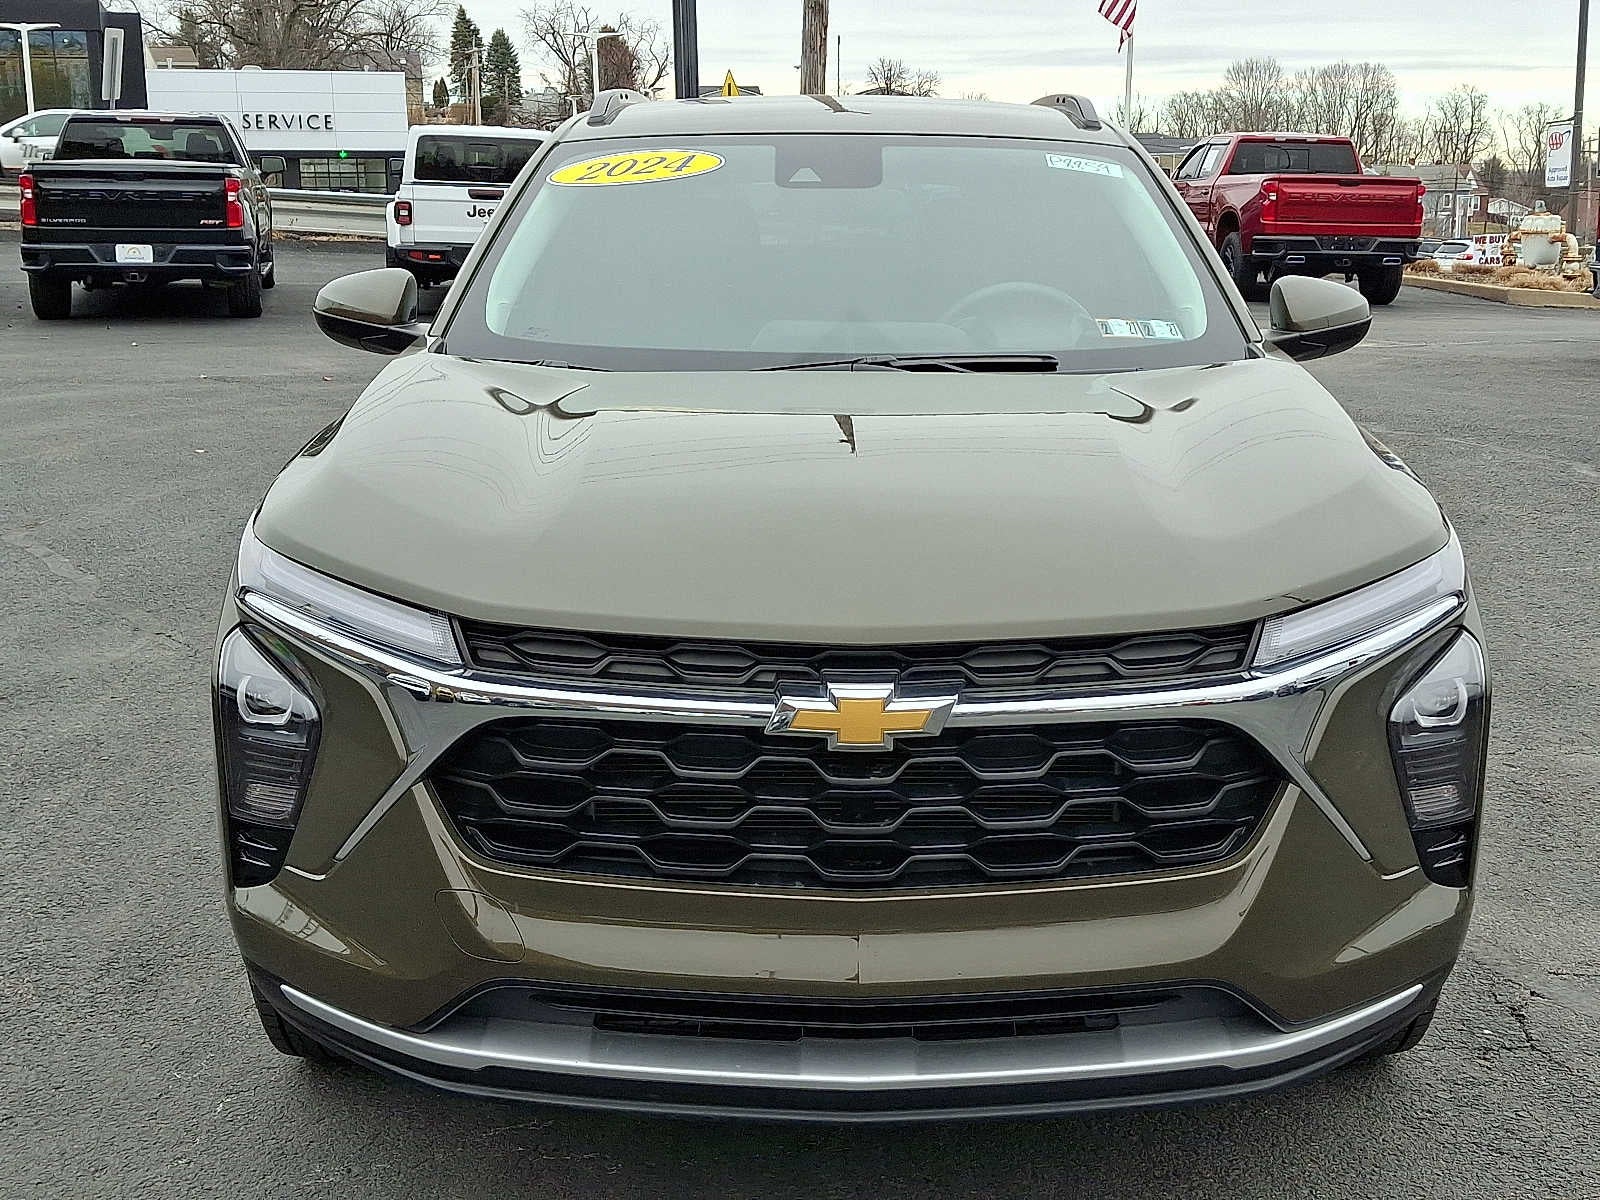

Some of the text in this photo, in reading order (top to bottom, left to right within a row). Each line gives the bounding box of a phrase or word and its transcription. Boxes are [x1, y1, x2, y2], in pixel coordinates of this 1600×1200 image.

[242, 113, 334, 130] SERVICE
[575, 154, 698, 181] 2024
[466, 204, 495, 218] Jee
[1474, 234, 1507, 245] WE BUY
[1478, 256, 1501, 265] CARS
